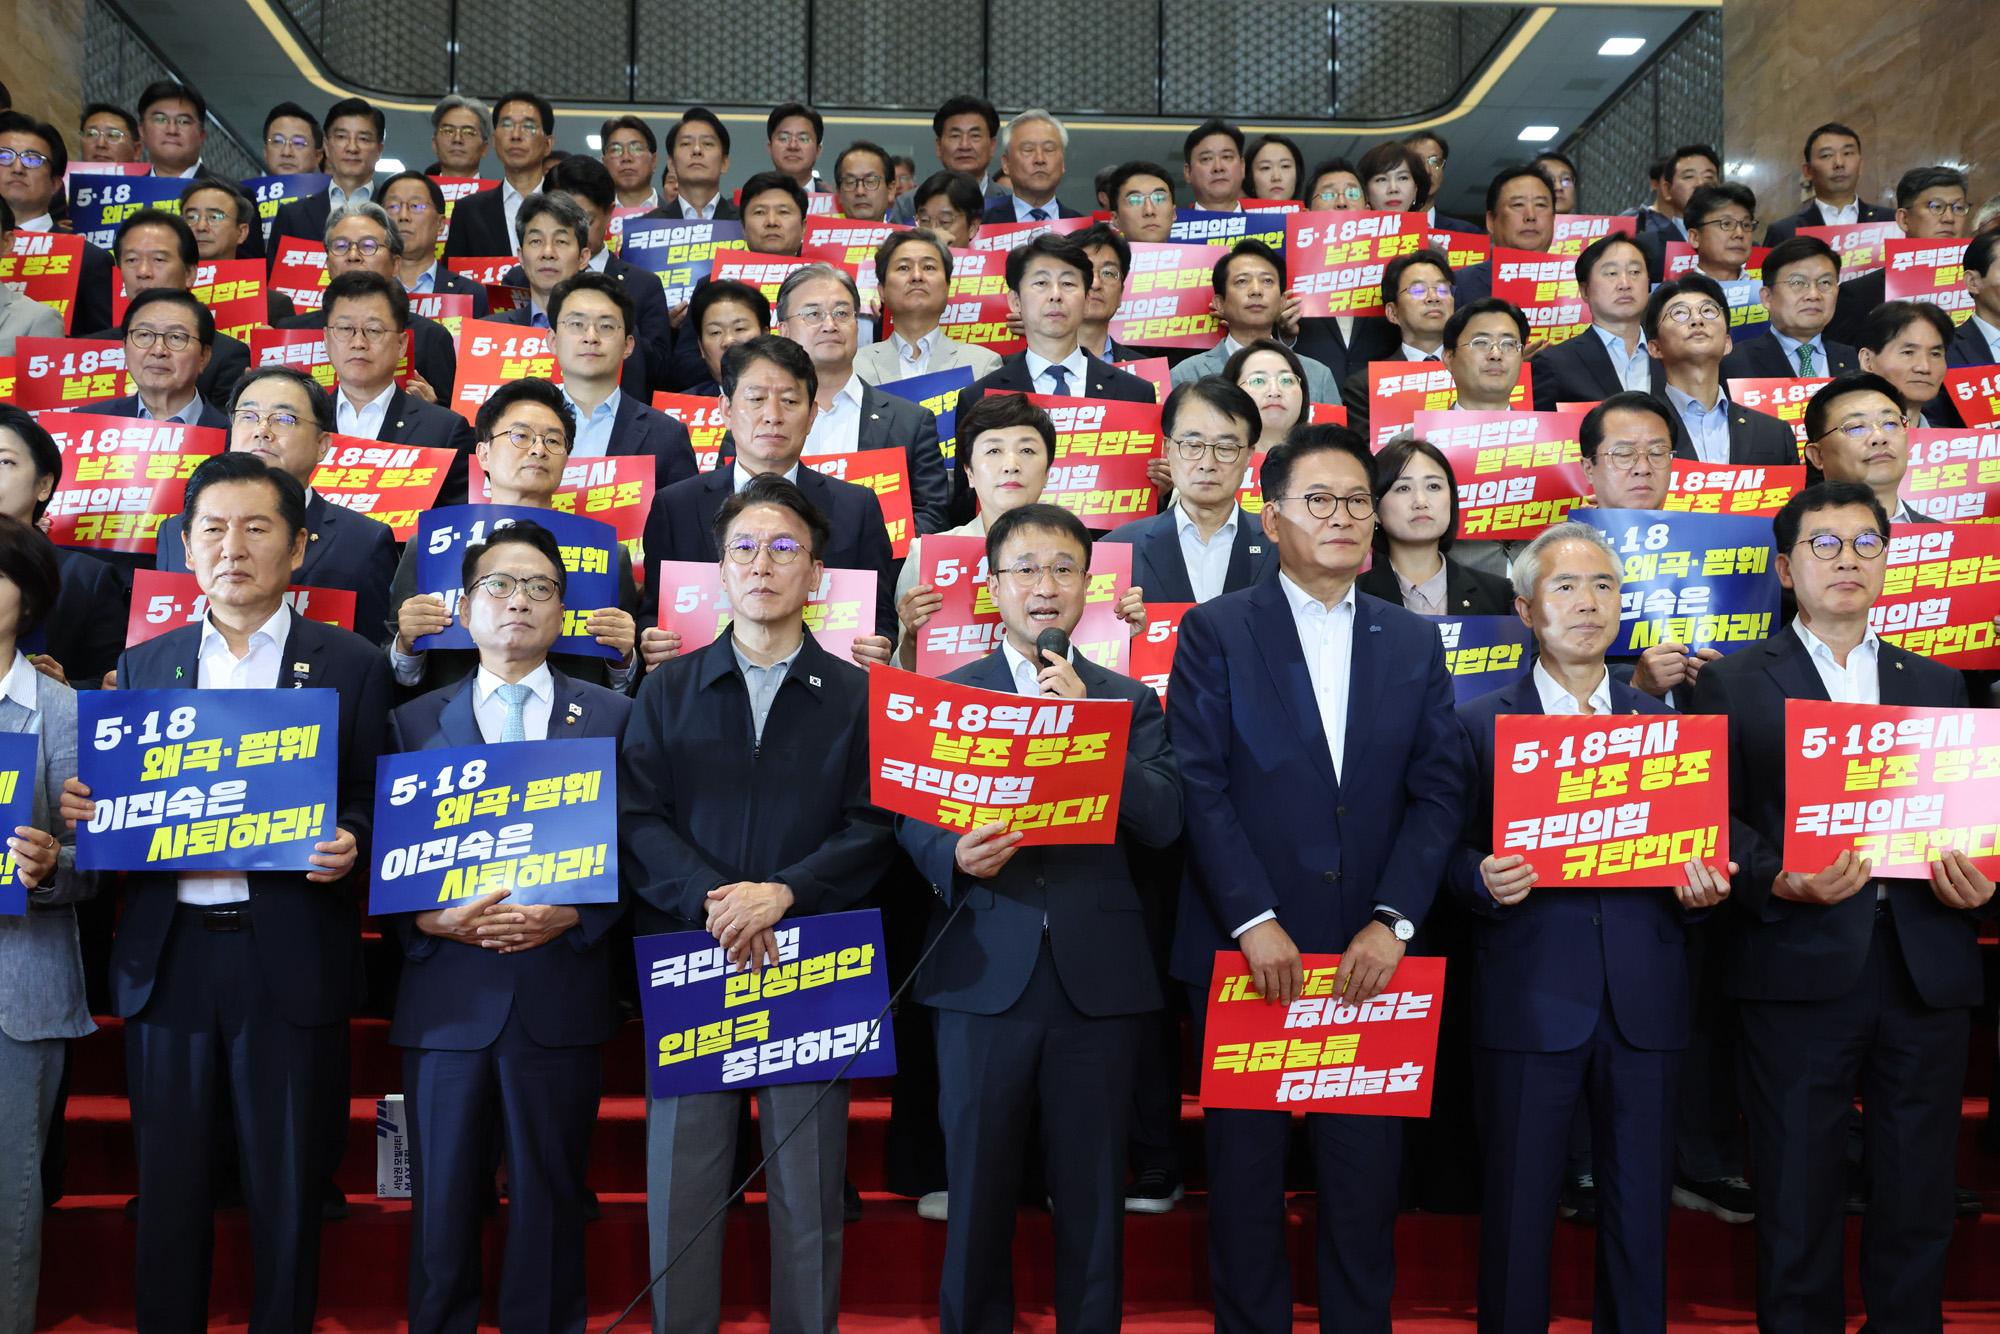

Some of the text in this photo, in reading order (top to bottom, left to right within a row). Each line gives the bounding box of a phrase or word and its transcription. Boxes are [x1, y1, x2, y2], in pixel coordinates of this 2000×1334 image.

[77, 184, 131, 207] 5·18
[629, 224, 713, 249] 국민의힘
[1170, 217, 1247, 240] 국민의힘
[1296, 214, 1401, 248] 5·18역사
[21, 255, 72, 275] 방조
[1325, 239, 1371, 265] 날조
[1378, 233, 1420, 257] 방조
[1448, 250, 1485, 267] 잡는
[1892, 245, 1970, 271] 주택법
[190, 280, 260, 305] 목잡는
[1292, 264, 1385, 295] 국민의힘
[1535, 281, 1582, 302] 발목
[1111, 296, 1179, 321] 민의힘
[1122, 315, 1219, 341] 규탄한다!
[28, 348, 127, 378] 5·18역
[500, 358, 555, 379] 날조
[62, 374, 117, 400] 날조
[1377, 369, 1456, 398] 주택법
[1424, 418, 1538, 451] 주택법안
[75, 456, 138, 481] 날조
[310, 467, 438, 488] 날조 방조
[561, 460, 617, 489] 역사
[1909, 463, 1968, 492] 날조
[585, 481, 643, 512] 방조
[1729, 486, 1792, 512] 방조
[74, 513, 172, 541] 규탄한
[1623, 546, 1770, 584] 왜곡·폄훼
[1620, 586, 1710, 621] 진숙은
[1629, 613, 1772, 650] 사퇴하라!
[94, 706, 197, 751] 5·18
[885, 693, 1075, 735] 5·18역사
[140, 725, 321, 782] 왜곡·폄훼
[931, 732, 1111, 767] 날조 방조
[1511, 719, 1678, 774] 5·18역사
[1803, 713, 1976, 759] 5·18역사
[390, 759, 487, 806] 5·18
[880, 758, 1034, 805] 국민의힘
[1557, 749, 1712, 804] 날조 방조
[1844, 754, 1920, 791] 날조
[88, 780, 247, 833] 이진숙은
[434, 770, 602, 830] 왜곡·폄훼
[937, 795, 1109, 835] 규탄한다!
[1795, 794, 1944, 837] 국민의힘
[146, 803, 325, 862] 사퇴하라!
[1504, 801, 1650, 851] 국민의힘
[381, 822, 533, 881] 이진숙은
[1562, 825, 1719, 880] 규탄한다!
[437, 844, 608, 903] 사퇴하라!
[724, 943, 875, 1009] 민생법안
[1284, 991, 1433, 1029] 국민의힘
[658, 1010, 770, 1067] 인질극
[722, 1018, 881, 1084] 중단하라!
[1212, 1033, 1361, 1074] 발목잡는
[1276, 1061, 1424, 1103] 주택법안
